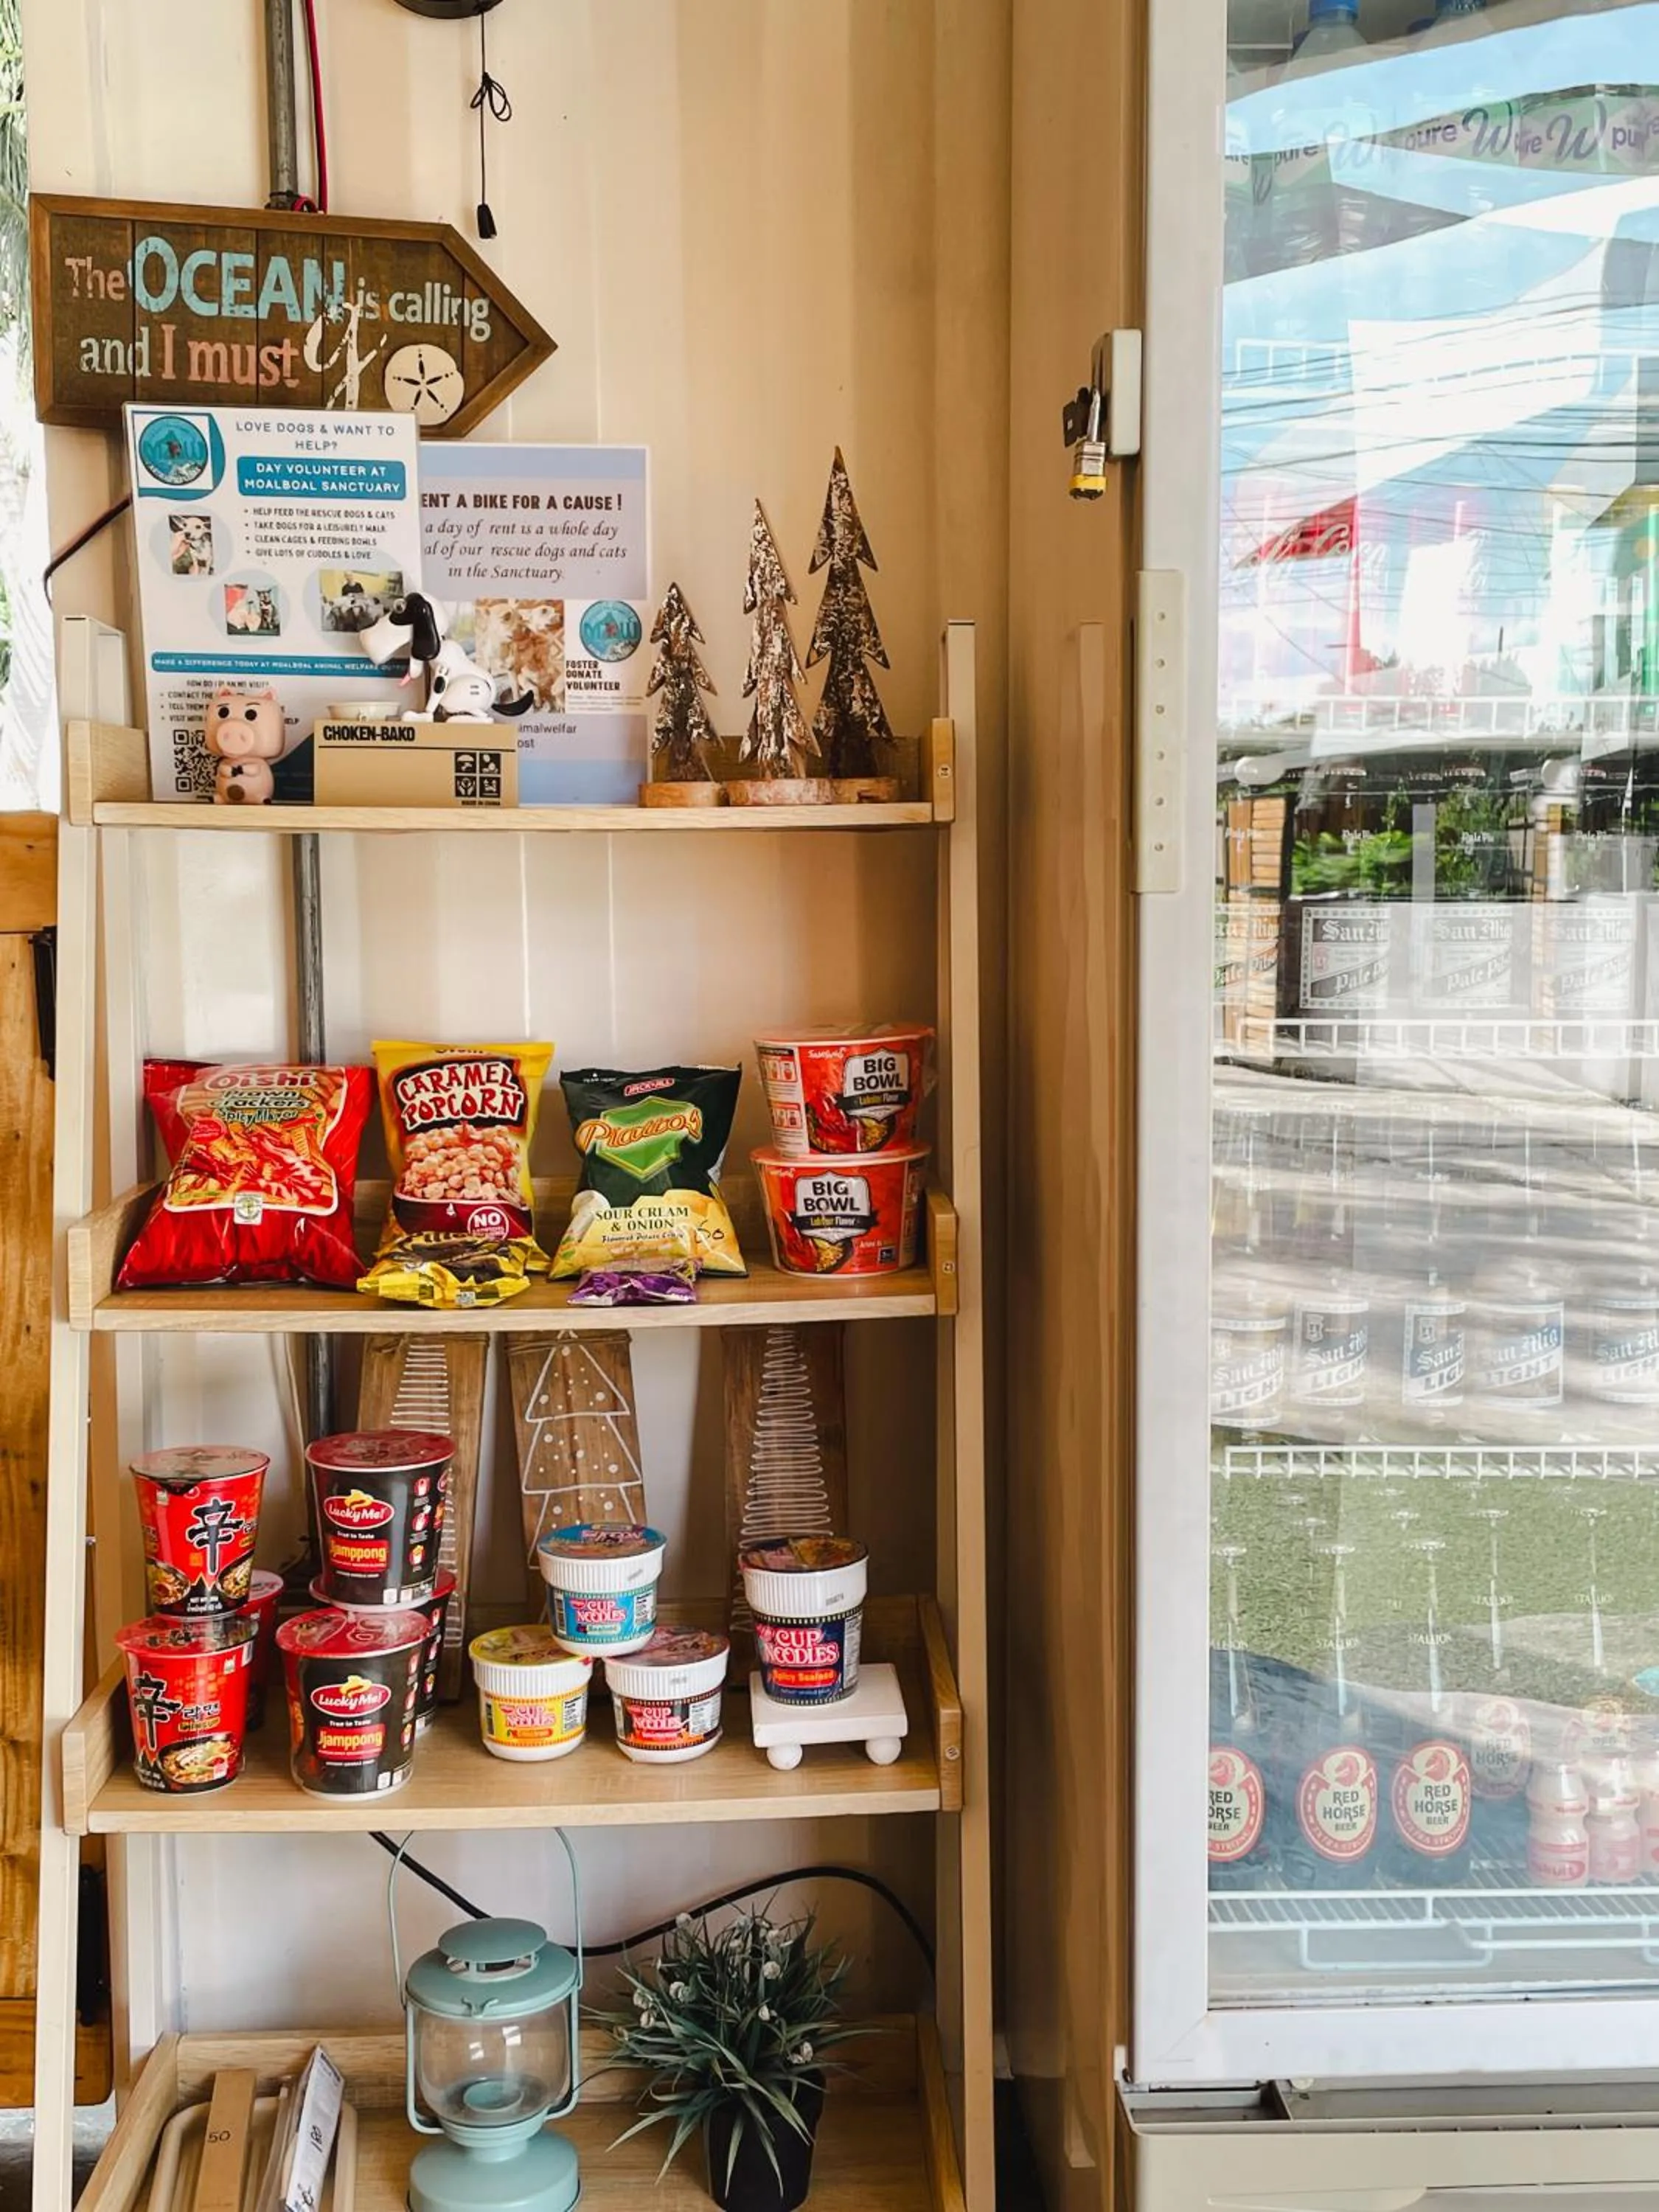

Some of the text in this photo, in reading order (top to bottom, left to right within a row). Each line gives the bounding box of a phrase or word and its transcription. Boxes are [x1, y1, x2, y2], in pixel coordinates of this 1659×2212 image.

[66, 236, 490, 343] The OCEAN is calling
[80, 327, 150, 378] and
[161, 324, 176, 380] I
[187, 337, 299, 389] must
[236, 421, 395, 436] LOVE DOGS & WANT TO
[295, 440, 338, 451] HELP?
[257, 462, 386, 476] DAY VOLUNTEER AT
[245, 479, 400, 493] MOALBOAL SANCTUARY
[422, 493, 451, 507] ENT
[456, 495, 467, 508] A
[473, 495, 507, 509] BIKE
[513, 495, 540, 509] FOR
[546, 496, 557, 510] A
[563, 495, 612, 510] CAUSE
[253, 507, 271, 515] HELP
[274, 508, 293, 516] FEED
[311, 509, 341, 518] RESCUE
[344, 510, 364, 518] DOGS
[375, 511, 395, 519] CATS
[276, 522, 296, 530] DOGS
[324, 524, 364, 532] LEISURELY
[366, 524, 386, 532] WALK
[425, 518, 618, 540] a day of rent is a whole day
[254, 535, 279, 543] CLEAN
[318, 537, 349, 545] FEEDING
[352, 538, 377, 546] BOWLS
[256, 549, 271, 557] GIVE
[274, 549, 293, 557] LOTS
[296, 549, 305, 557] OF
[307, 549, 341, 558] CUDDLES
[352, 551, 372, 560] LOVE
[441, 540, 458, 558] of
[459, 545, 484, 556] our
[490, 545, 531, 557] rescue
[535, 541, 565, 562] dogs
[569, 543, 595, 558] and
[599, 546, 627, 558] cats
[448, 565, 462, 577] in
[467, 563, 487, 578] the
[566, 661, 599, 669] FOSTER
[566, 670, 602, 678] DONATE
[566, 681, 620, 691] VOLUNTEER
[323, 726, 415, 742] CHOKEN-BAKO
[1322, 920, 1363, 941] San
[1438, 920, 1475, 940] San
[1335, 969, 1370, 992] Pale
[1447, 968, 1484, 992] Pale
[863, 1057, 895, 1074] BIG
[209, 1072, 310, 1089] Oishi
[400, 1063, 515, 1102] CARAMEL
[853, 1074, 903, 1091] BOWL
[210, 1097, 308, 1107] Crackers
[404, 1088, 522, 1128] POPCORN
[812, 1181, 849, 1195] BIG
[804, 1197, 860, 1212] BOWL
[473, 1213, 501, 1225] NO
[596, 1208, 688, 1220] SOUR CREAM
[611, 1219, 674, 1231] & ONION
[1416, 1346, 1454, 1372] San
[329, 1503, 361, 1522] Lucky
[588, 1601, 616, 1610] CUP
[577, 1610, 626, 1623] NOODLES
[776, 1630, 821, 1647] CUP
[764, 1644, 838, 1664] NOODLES
[319, 1694, 357, 1710] Lucky
[517, 1705, 545, 1715] CUP
[643, 1708, 672, 1719] CUP
[507, 1714, 556, 1726] NOODLES
[634, 1717, 682, 1729] NOODLES
[319, 1731, 382, 1751] Jjamppong
[1333, 1791, 1359, 1804] RED
[1424, 1784, 1451, 1799] RED
[1323, 1805, 1366, 1821] HORSE
[1414, 1800, 1458, 1815] HORSE
[1335, 1822, 1357, 1832] BEER
[1426, 1816, 1449, 1825] BEER
[207, 2130, 231, 2143] 50
